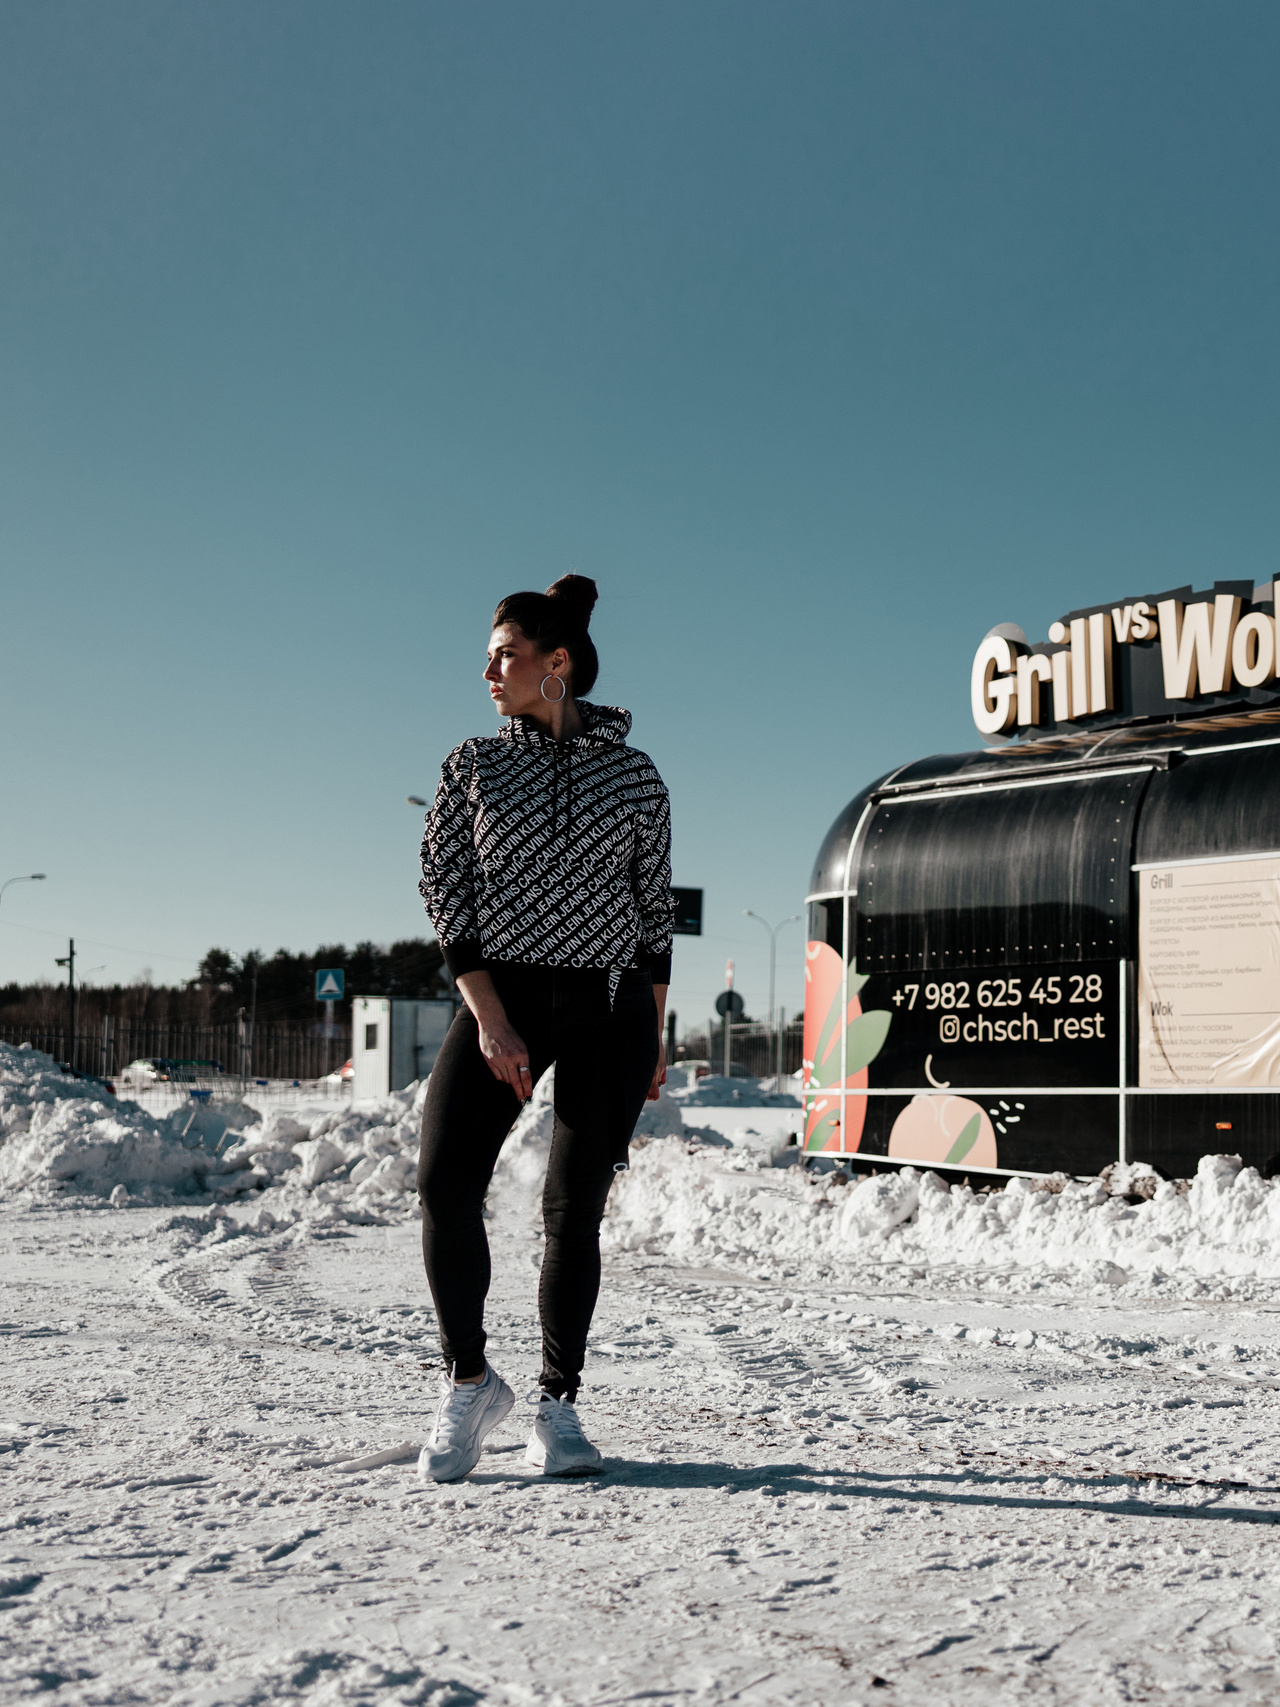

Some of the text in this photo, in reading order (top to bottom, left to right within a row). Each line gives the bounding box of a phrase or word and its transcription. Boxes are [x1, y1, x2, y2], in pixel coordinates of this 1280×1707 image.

[971, 612, 1112, 735] Grill
[502, 769, 535, 795] CALVIN
[508, 753, 536, 776] KLEIN
[494, 809, 525, 837] KLEIN
[521, 791, 551, 815] JEANS
[498, 790, 528, 814] JEANS
[525, 768, 555, 795] CALVIN
[517, 811, 549, 837] KLEIN
[571, 773, 603, 795] CALVIN
[592, 795, 620, 818] JEANS
[436, 812, 464, 844] CALVIN
[512, 832, 547, 862] CALVIN
[570, 791, 598, 818] JEANS
[559, 834, 593, 863] CALVIN
[588, 814, 618, 841] KLEIN
[614, 803, 638, 822] JEAN
[582, 836, 614, 864] CALVIN
[490, 883, 520, 912] JEANS
[640, 876, 665, 905] CALVIN
[1150, 873, 1174, 890] Grill
[443, 912, 470, 947] CALVIN
[482, 930, 512, 958] CALVIN
[508, 910, 539, 937] KLEIN
[536, 886, 566, 916] JEANS
[489, 907, 516, 933] KLEIN
[513, 884, 543, 914] JEANS
[499, 932, 536, 961] CALVIN
[531, 911, 562, 939] KLEIN
[559, 887, 589, 917] JEANS
[523, 934, 559, 963] CALVIN
[554, 912, 585, 940] KLEIN
[582, 888, 612, 919] JEANS
[547, 936, 582, 967] CALVIN
[578, 913, 608, 942] KLEIN
[605, 890, 631, 920] JEANS
[571, 936, 605, 968] CALVIN
[600, 914, 628, 942] KLEIN
[595, 921, 638, 968] CALVIN KLE
[892, 974, 1102, 1011] +7 982 625 45 28
[1150, 1001, 1174, 1017] Wok
